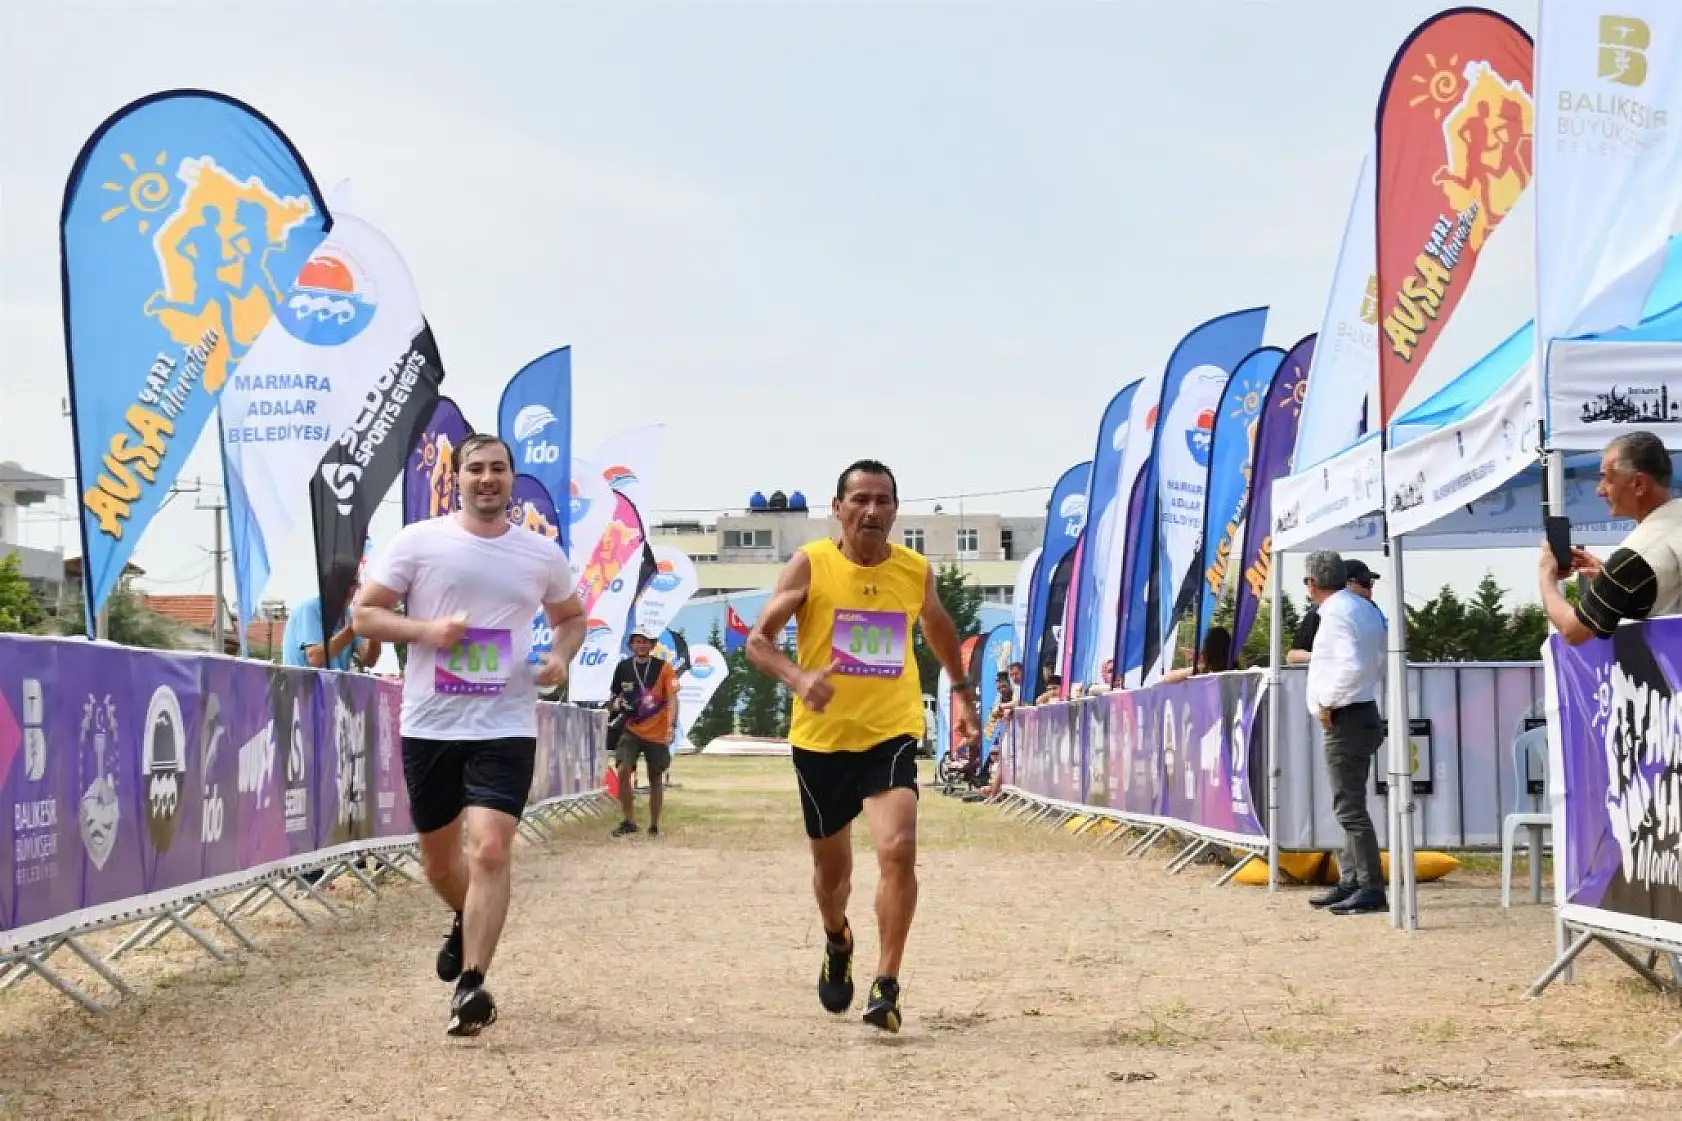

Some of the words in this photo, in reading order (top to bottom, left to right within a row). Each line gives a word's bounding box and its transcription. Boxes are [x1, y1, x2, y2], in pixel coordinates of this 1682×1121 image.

[235, 373, 331, 393] MARMARA
[247, 399, 317, 417] ADALAR
[355, 400, 401, 467] SPORTS
[391, 349, 426, 404] EVENTS
[525, 440, 560, 464] ido
